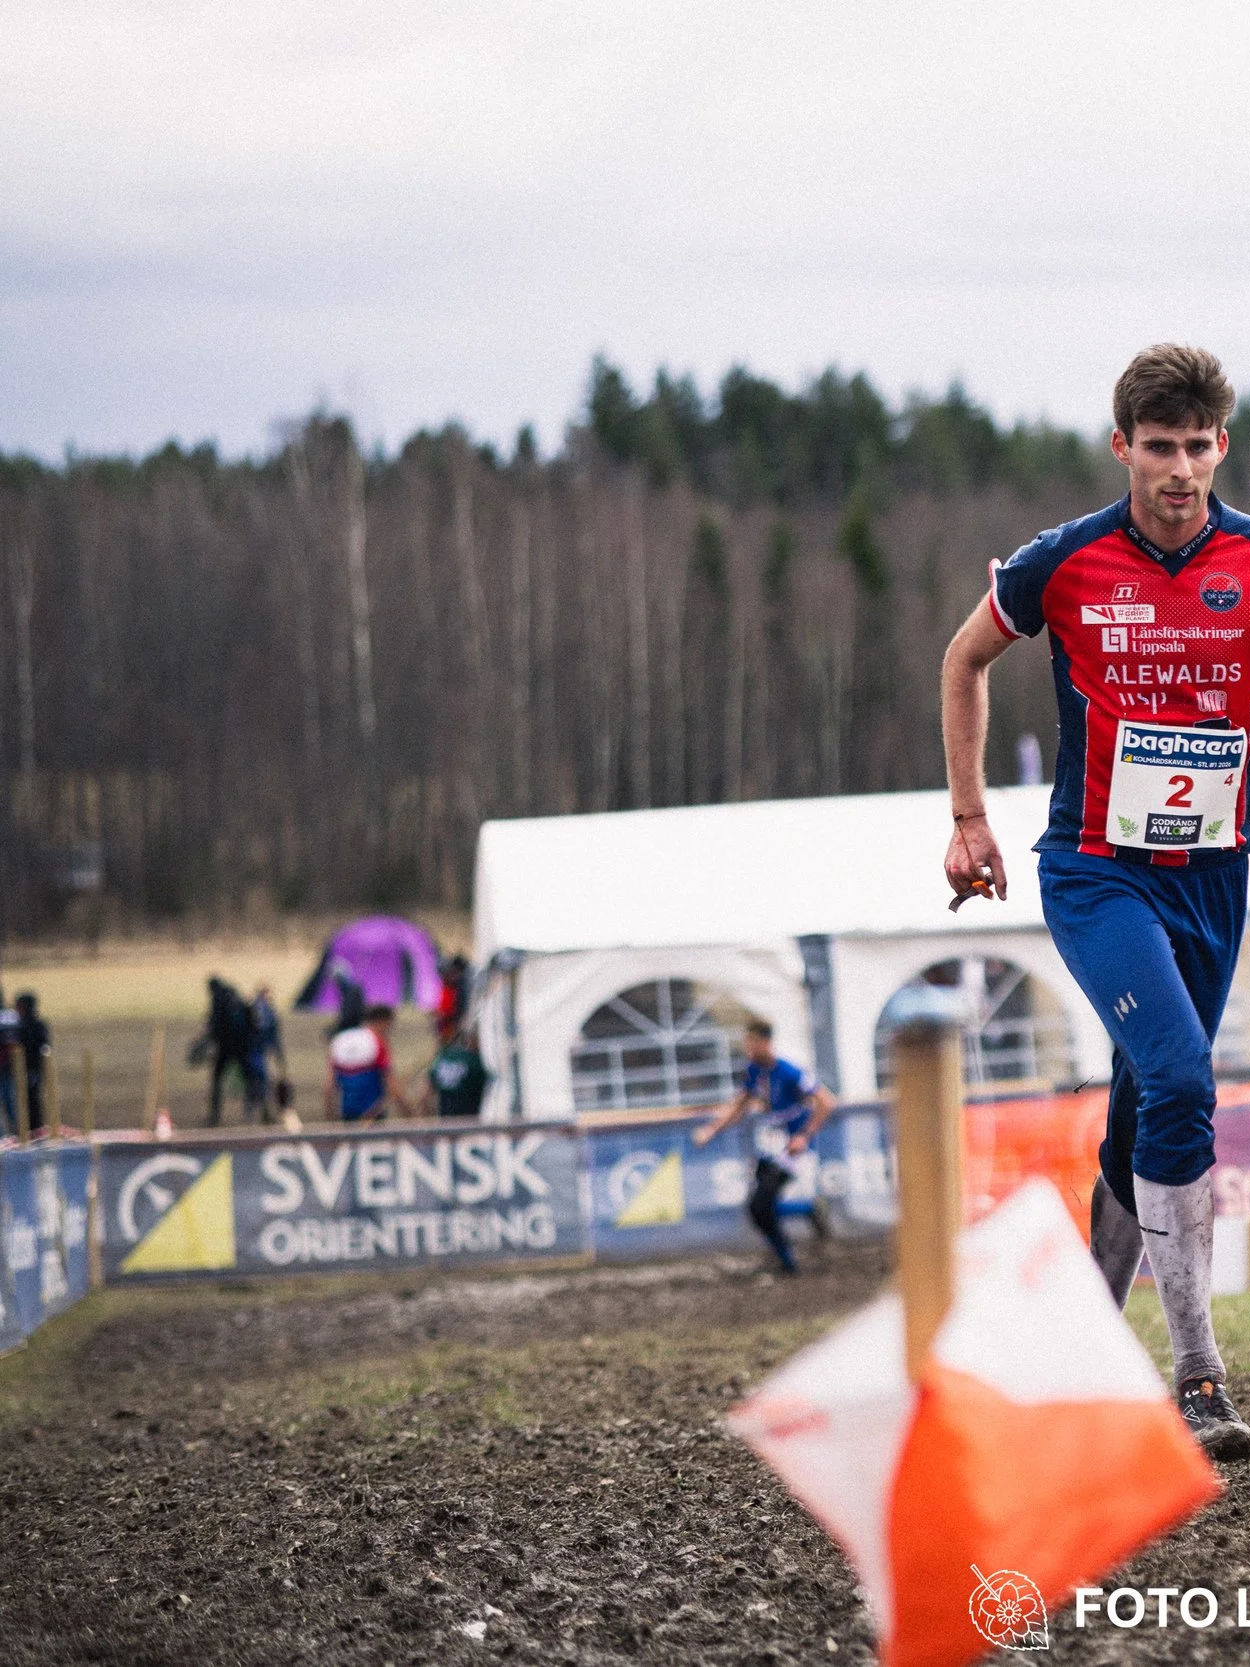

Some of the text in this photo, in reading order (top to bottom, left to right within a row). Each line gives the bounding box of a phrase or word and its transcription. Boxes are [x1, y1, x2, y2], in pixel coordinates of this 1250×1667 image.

[1128, 527, 1141, 540] OK
[1180, 524, 1213, 557] UPPSALA
[1131, 626, 1244, 641] Länsförsäkringar
[1131, 640, 1186, 656] Uppsala
[1104, 662, 1242, 685] ALEWALDS
[1123, 729, 1244, 756] bagheera
[1165, 774, 1194, 808] 2
[1223, 773, 1234, 786] 4
[1151, 817, 1198, 827] GODKÄNDA
[260, 1131, 550, 1214] SVENSK
[260, 1204, 557, 1266] ORIENTERING
